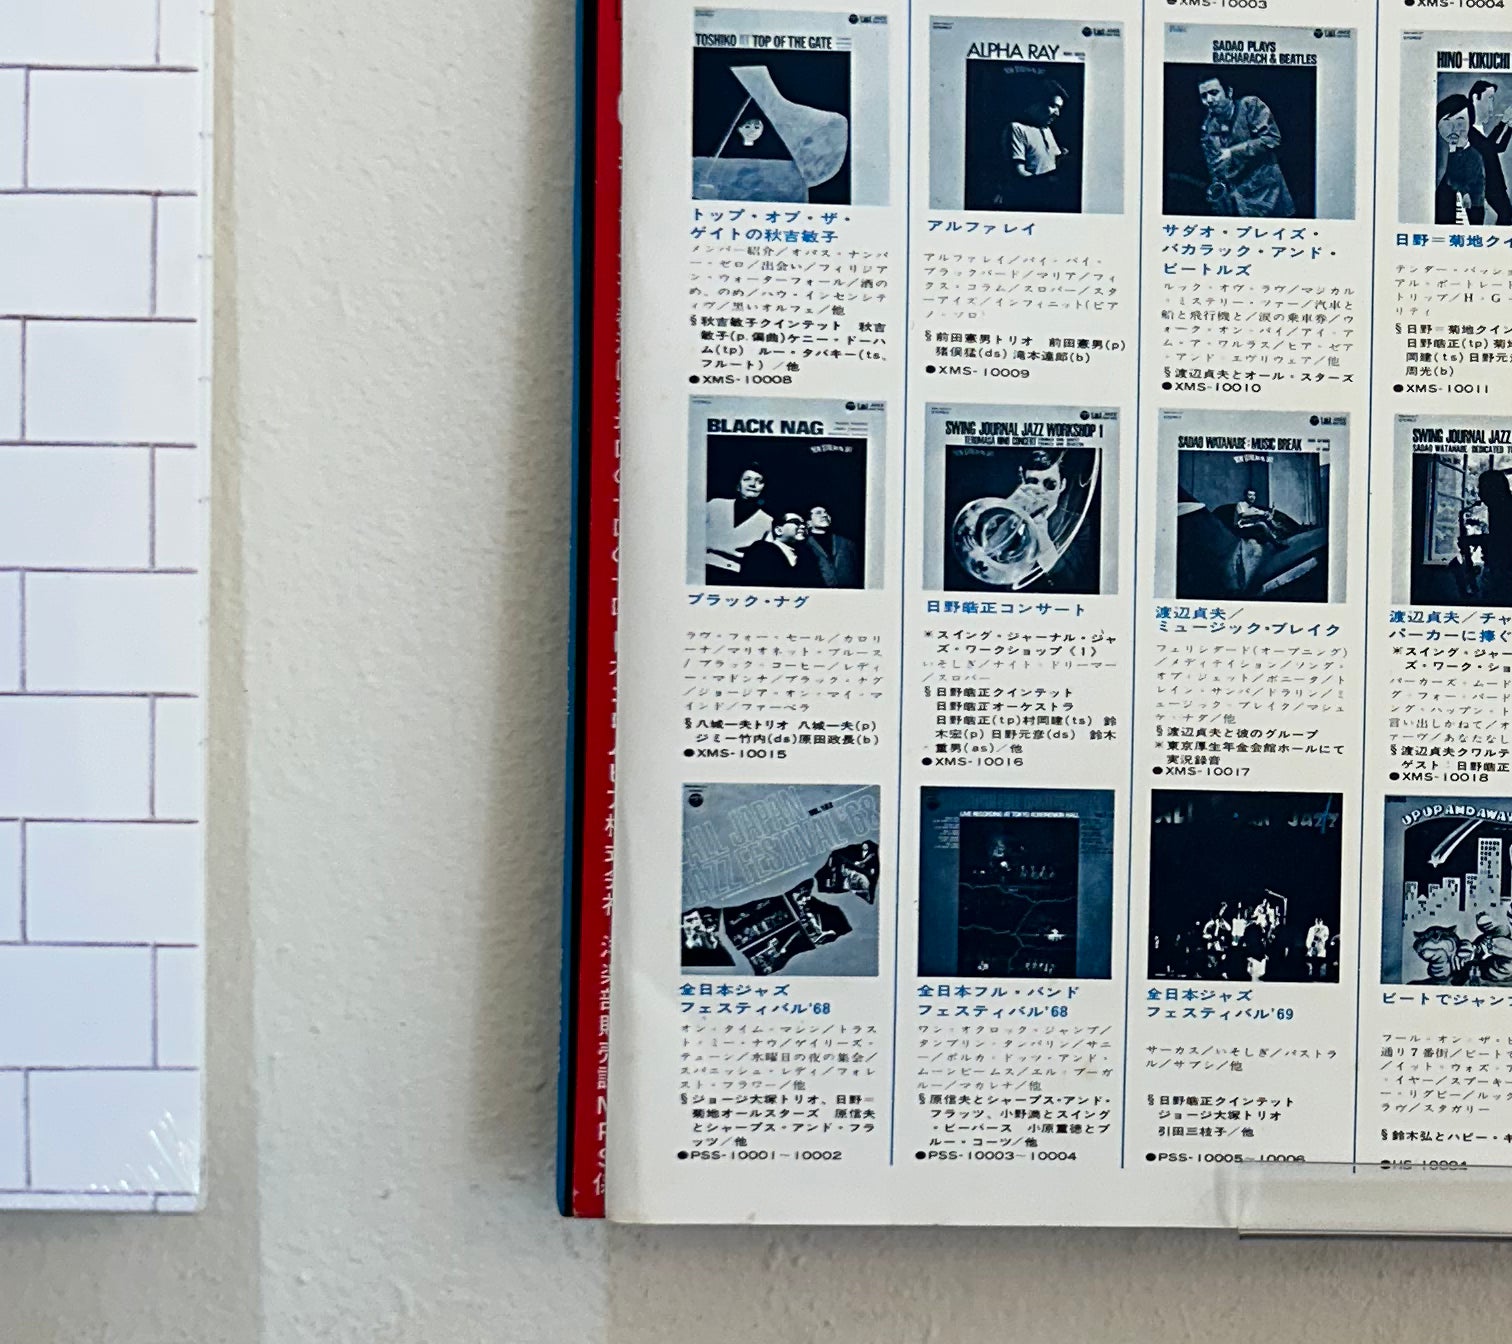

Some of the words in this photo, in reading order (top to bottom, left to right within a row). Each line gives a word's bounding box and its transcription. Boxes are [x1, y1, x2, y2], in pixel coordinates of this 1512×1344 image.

[695, 32, 738, 48] TOSHIKO
[751, 34, 772, 48] TOP
[773, 35, 787, 49] OF
[788, 35, 807, 49] THE
[807, 35, 833, 51] GATE
[1211, 38, 1245, 53] SADAO
[1246, 39, 1277, 53] PLAYS
[967, 41, 1025, 59] ALPHA
[1027, 42, 1061, 61] RAY
[1212, 52, 1268, 65] BACHARACH
[1268, 53, 1278, 65] &
[1278, 53, 1318, 65] BEATLES
[702, 372, 793, 386] XMS-10008
[938, 363, 1031, 380] XMS-10009
[1174, 380, 1262, 395] XMS-10010
[1405, 382, 1491, 395] XMS-10011
[707, 417, 774, 434] BLACK
[779, 419, 826, 436] NAG
[945, 420, 977, 436] SWING
[978, 421, 1020, 436] JOURNAL
[1020, 422, 1045, 437] JAZZ
[1045, 422, 1097, 438] WORKSHOP
[1250, 437, 1276, 451] MUSIC
[1412, 427, 1444, 445] SWING
[1445, 428, 1487, 445] JOURNAL
[1487, 428, 1512, 446] JAZZ
[696, 746, 788, 760] XMS-10015
[934, 755, 1025, 768] XMS-10016
[1165, 765, 1251, 778] XMS-10017
[1402, 770, 1490, 783] XMS-10018
[1401, 809, 1422, 826] UP
[1420, 804, 1444, 822] UP
[1443, 804, 1477, 818] AND
